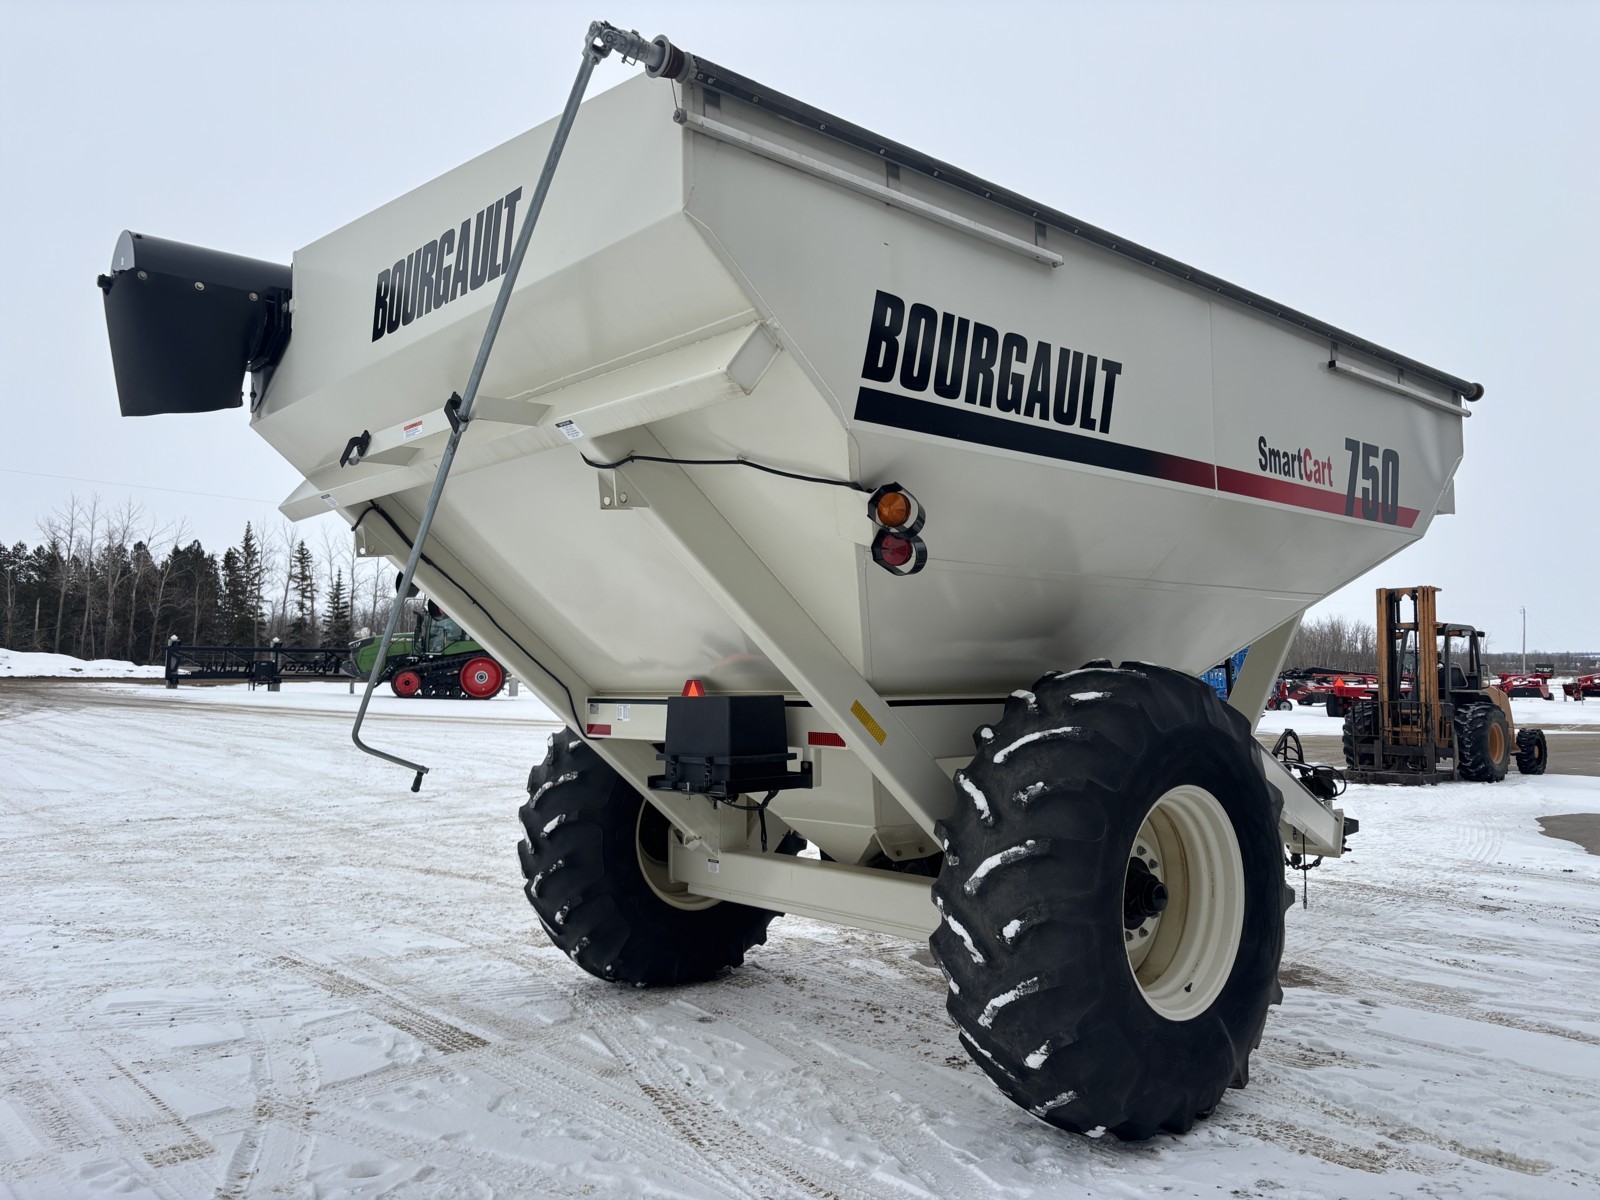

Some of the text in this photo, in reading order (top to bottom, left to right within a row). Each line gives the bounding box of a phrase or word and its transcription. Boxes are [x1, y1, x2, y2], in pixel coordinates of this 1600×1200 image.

[372, 186, 523, 343] BOURGAULT
[861, 289, 1122, 434] BOURGAULT
[1258, 436, 1399, 525] SmartCart 750
